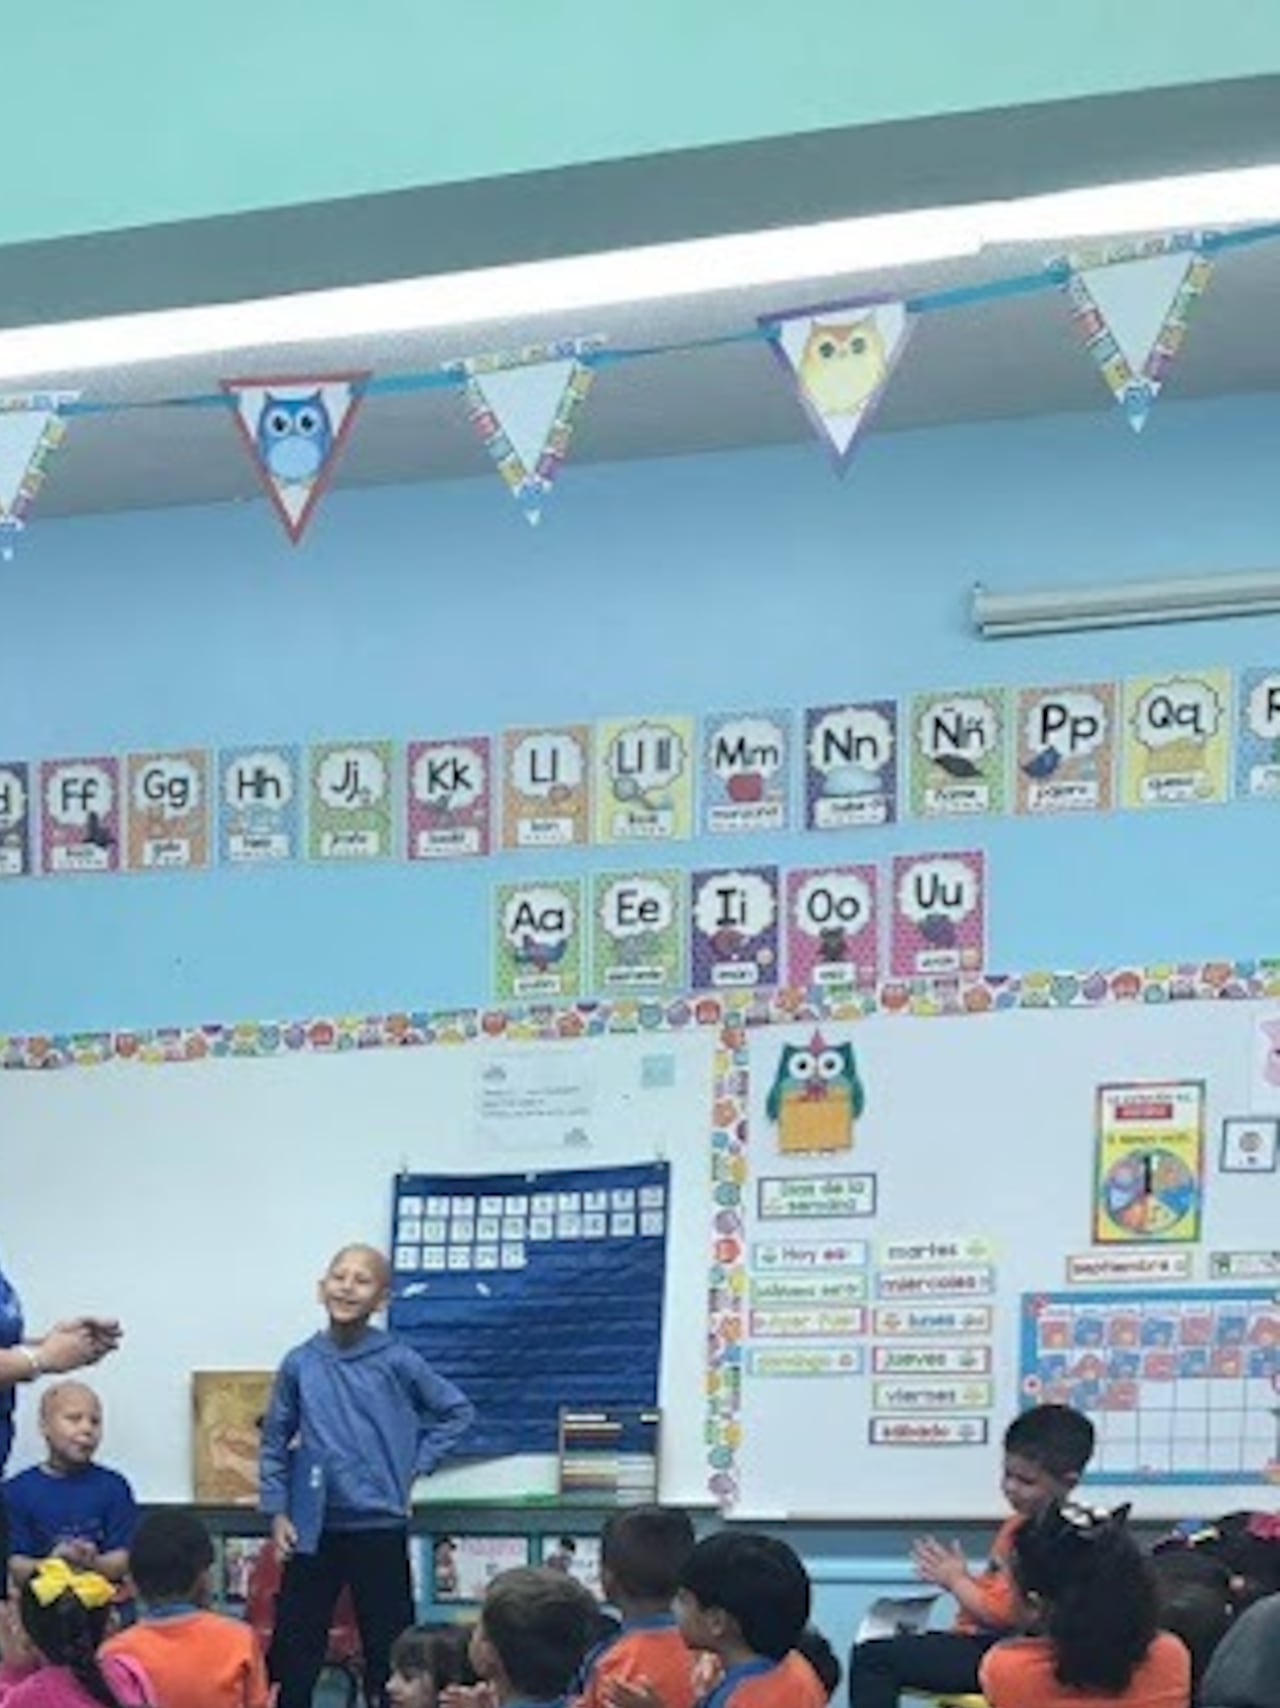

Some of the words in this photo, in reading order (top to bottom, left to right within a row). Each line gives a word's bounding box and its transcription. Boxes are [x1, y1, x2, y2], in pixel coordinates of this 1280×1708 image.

[933, 707, 984, 750] Ññ
[1040, 703, 1099, 750] Pp
[1148, 695, 1204, 734] Qq
[716, 735, 779, 769] Mm
[823, 726, 878, 763] Nn
[238, 768, 280, 799] Hh
[331, 759, 360, 802] Jj
[427, 757, 473, 793] Kk
[530, 748, 557, 782] Ll
[61, 777, 98, 812] Ff
[143, 769, 189, 808] Gg
[616, 889, 659, 926] Ee
[715, 886, 747, 926] Ii
[806, 888, 861, 923] Oo
[914, 872, 963, 909] Uu
[510, 900, 564, 935] Aa
[887, 1241, 959, 1260] martes
